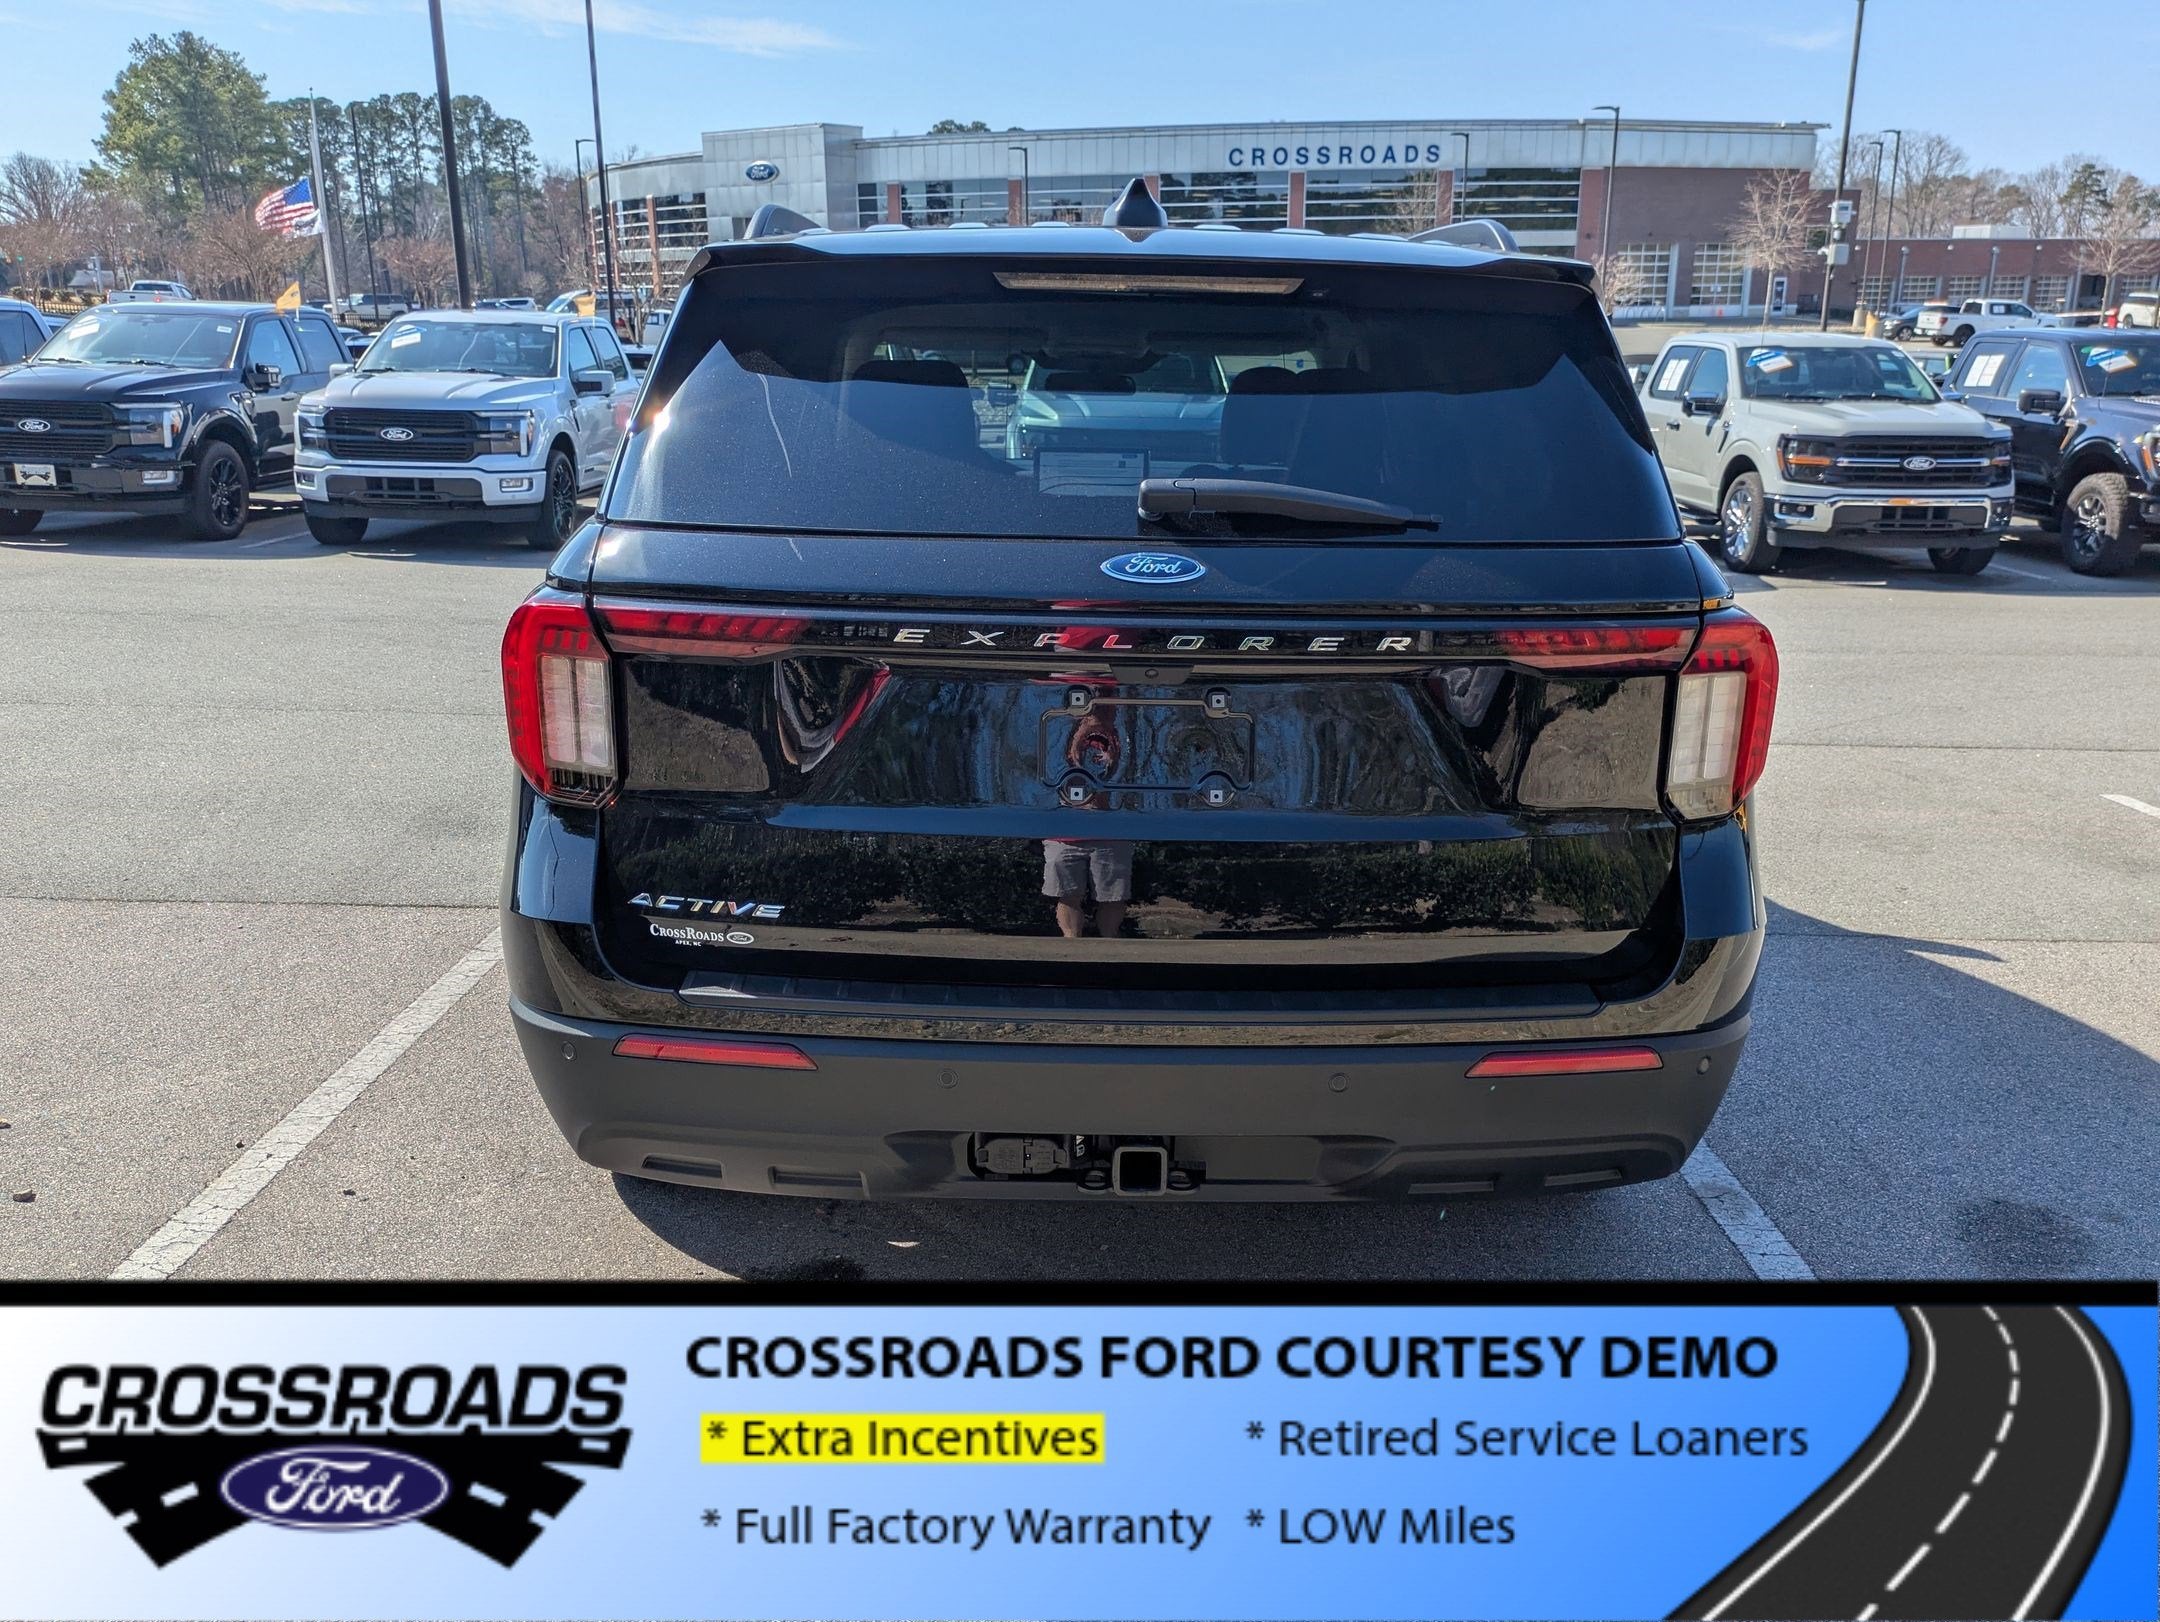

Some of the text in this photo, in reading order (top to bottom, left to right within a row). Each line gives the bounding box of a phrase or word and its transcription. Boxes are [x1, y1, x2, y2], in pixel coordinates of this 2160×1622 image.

[1228, 144, 1440, 167] CROSSROADS
[1124, 554, 1182, 575] Ford
[893, 628, 1412, 651] EXPLORER
[627, 892, 786, 919] ACTIVE
